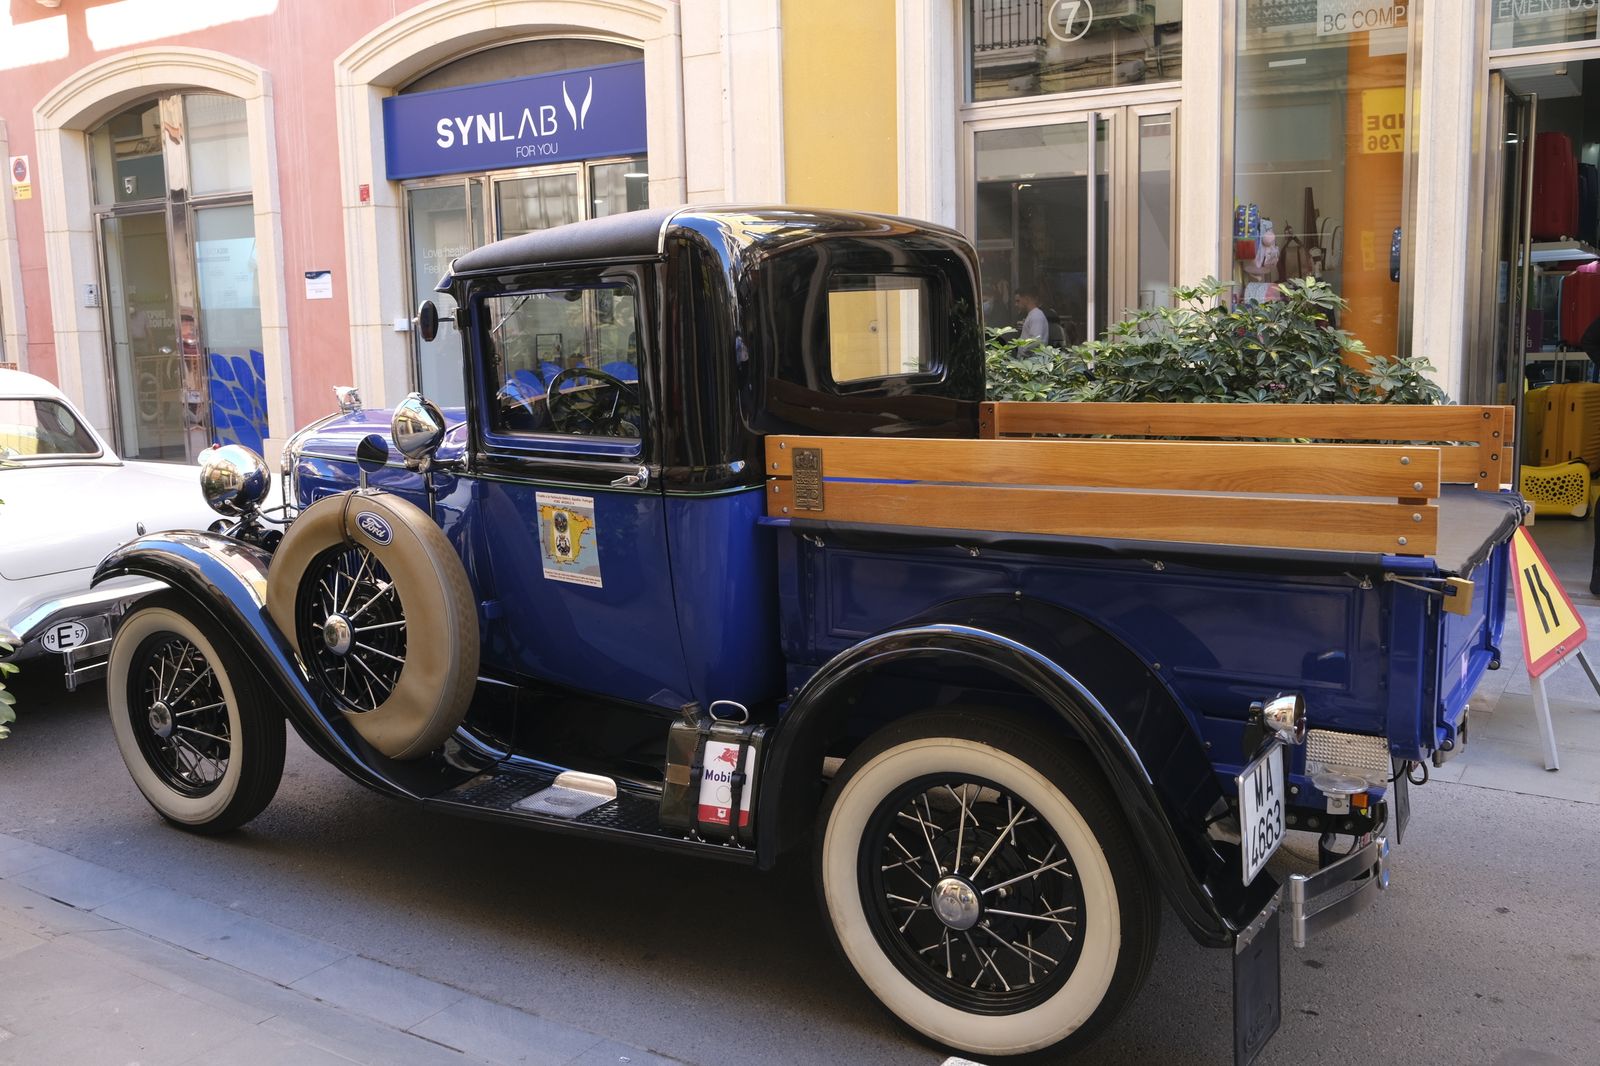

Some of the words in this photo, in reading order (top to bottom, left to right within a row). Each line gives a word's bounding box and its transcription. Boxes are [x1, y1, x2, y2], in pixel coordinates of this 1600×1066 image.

[1061, 0, 1081, 34] 7
[1323, 13, 1346, 32] BC
[436, 105, 558, 148] SYNLAB
[516, 145, 536, 158] FOR
[537, 143, 559, 155] YOU
[124, 176, 136, 194] 5
[423, 247, 442, 259] Love
[361, 517, 386, 538] Ford
[46, 634, 55, 644] 19
[57, 625, 74, 649] E
[75, 629, 85, 639] 57
[704, 769, 732, 784] Mobi
[1254, 757, 1274, 812] MA
[1252, 800, 1281, 867] 4663
